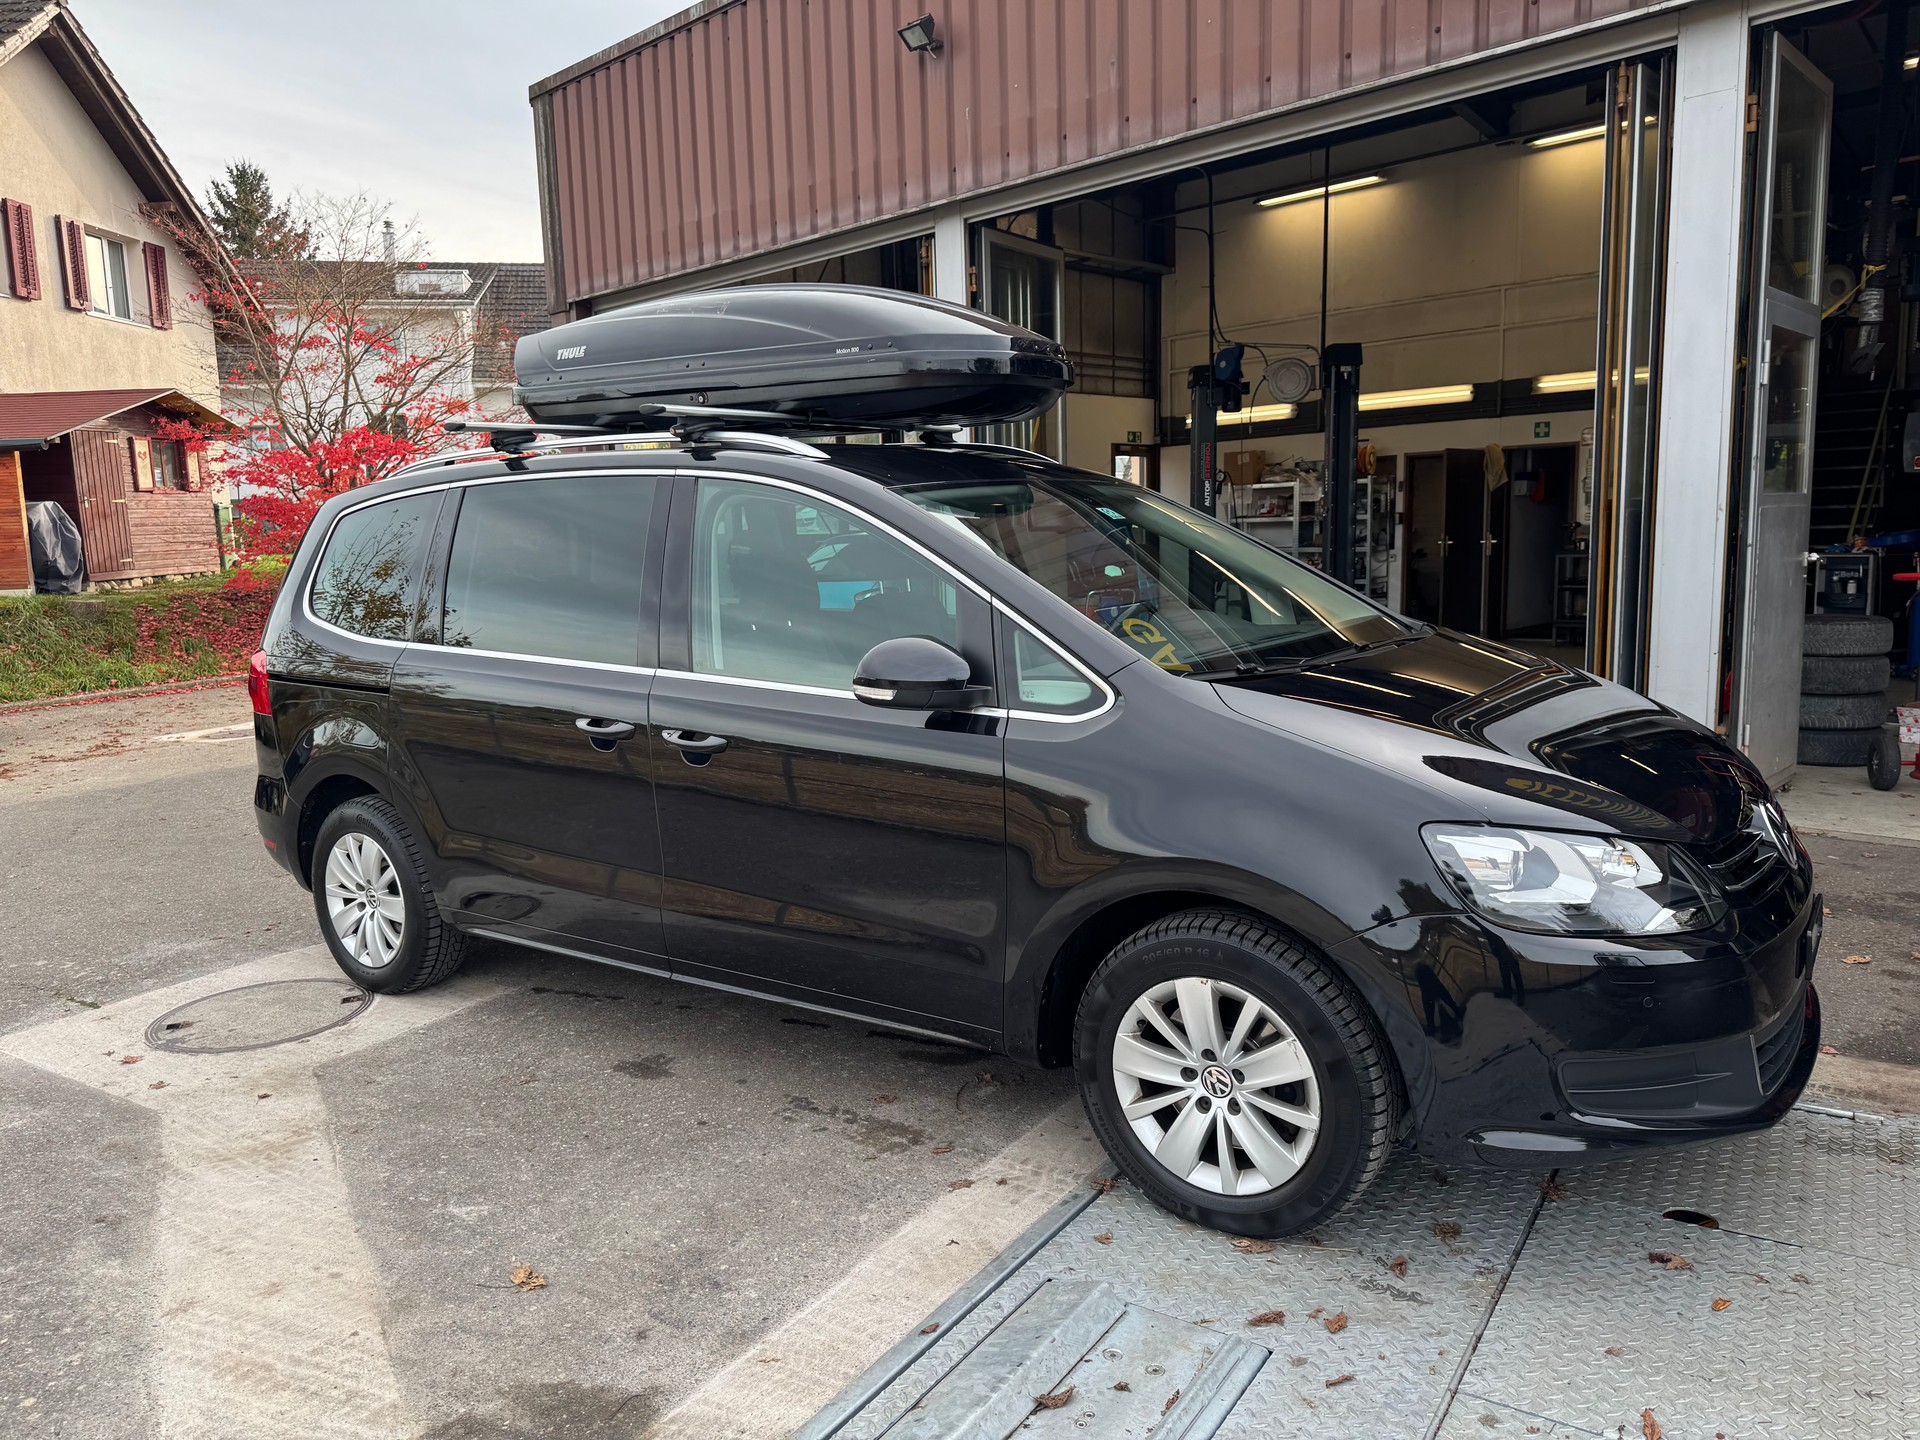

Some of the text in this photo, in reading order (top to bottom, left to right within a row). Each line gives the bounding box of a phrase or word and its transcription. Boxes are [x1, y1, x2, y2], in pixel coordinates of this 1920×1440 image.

[556, 345, 587, 361] THULE
[356, 813, 390, 844] Continental
[1142, 947, 1181, 965] 205/60
[1197, 948, 1210, 958] 16
